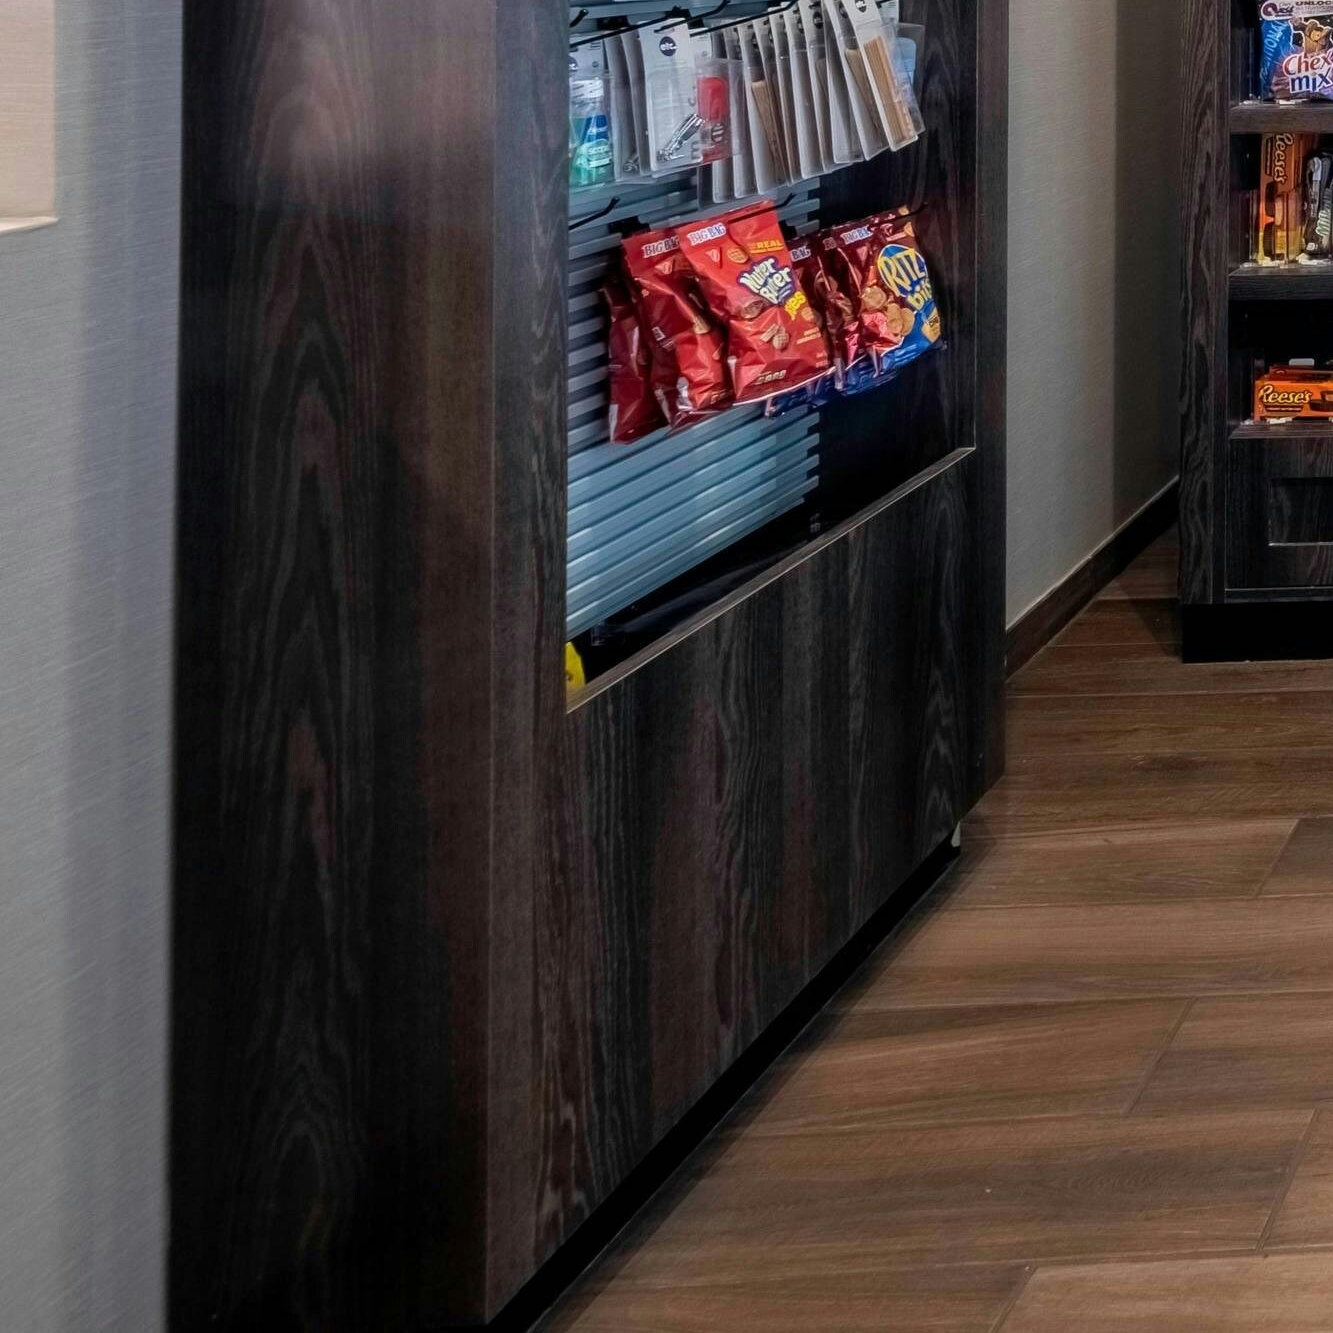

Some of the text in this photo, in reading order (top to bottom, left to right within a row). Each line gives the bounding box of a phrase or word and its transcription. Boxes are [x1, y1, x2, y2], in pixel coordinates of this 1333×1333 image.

[1273, 133, 1295, 184] Reese's
[688, 222, 727, 245] BIG BAG
[643, 241, 664, 257] BIG
[790, 247, 812, 262] BAG
[878, 248, 926, 297] RITZ
[1259, 384, 1313, 404] Reese's
